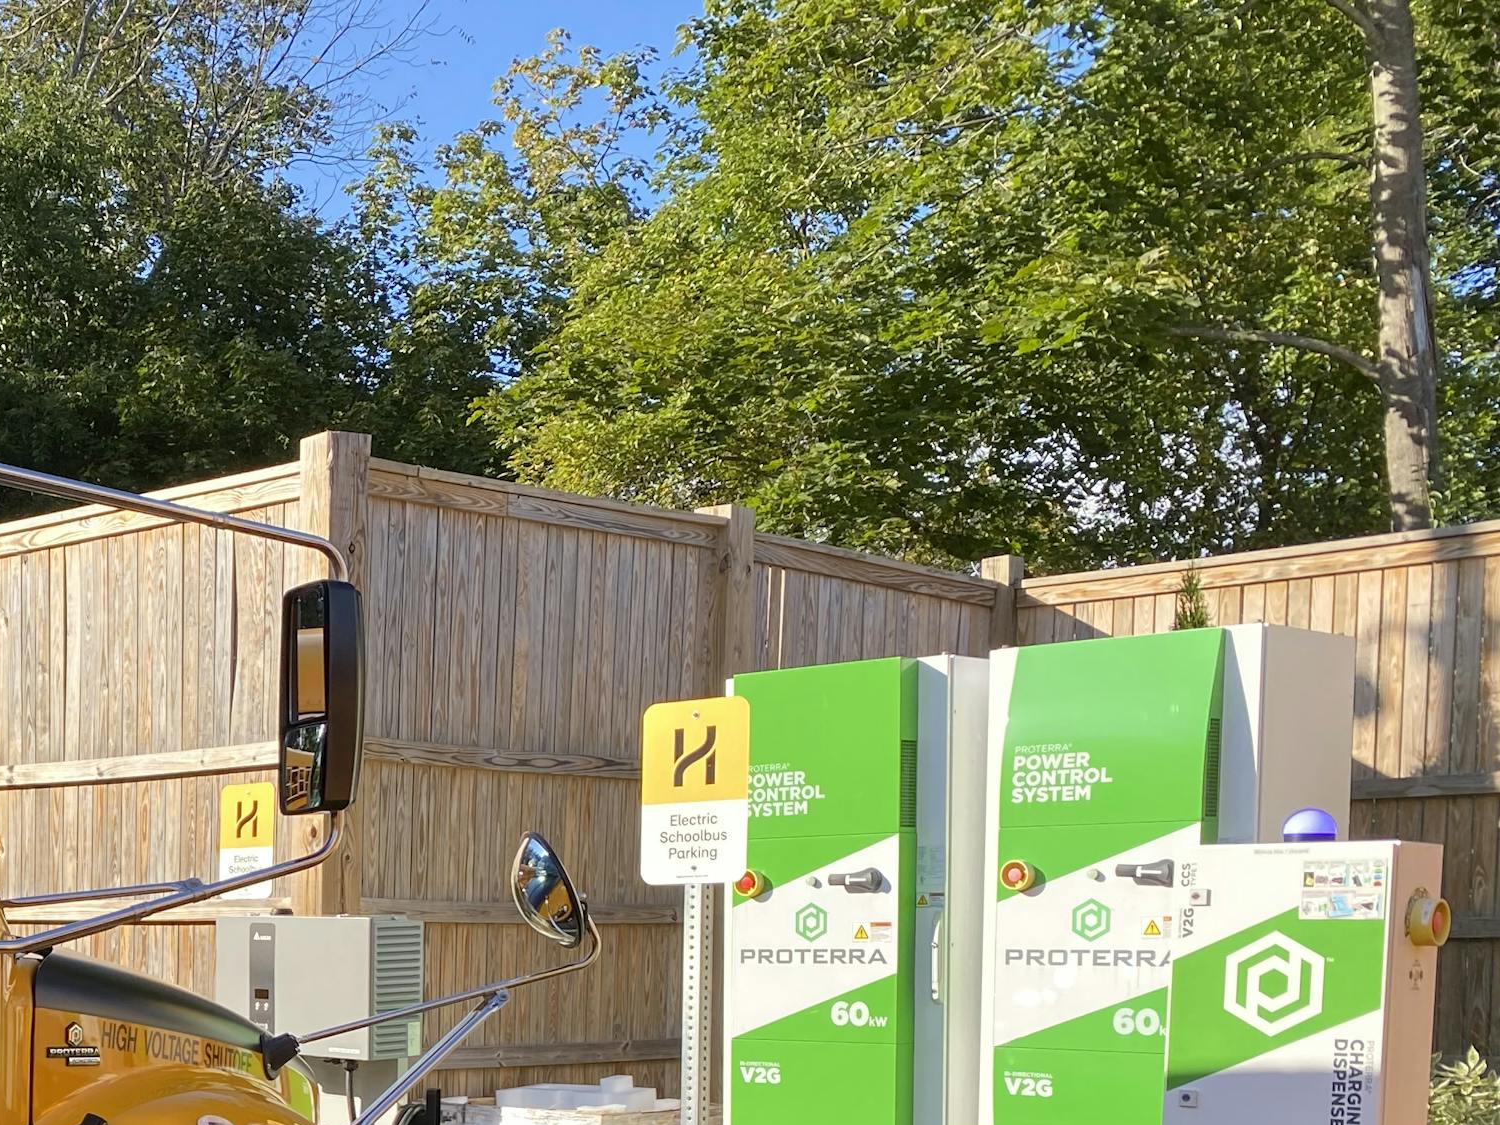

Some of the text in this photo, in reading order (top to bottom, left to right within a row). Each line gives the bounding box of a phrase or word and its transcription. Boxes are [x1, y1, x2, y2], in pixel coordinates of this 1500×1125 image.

[748, 763, 788, 773] ROTERRA
[1013, 752, 1091, 771] POWER
[1012, 767, 1113, 787] CONTROL
[1011, 785, 1092, 803] SYSTEM
[669, 813, 718, 827] Electric
[659, 830, 727, 844] Schoolbus
[668, 847, 718, 861] Parking
[1181, 863, 1192, 887] CCS
[1182, 907, 1195, 938] V2G
[740, 949, 888, 965] PROTERRA
[101, 1021, 253, 1074] HIGH VOLTAGE SHUTOFF
[740, 1066, 781, 1084] V2G
[1004, 1077, 1053, 1097] V2G
